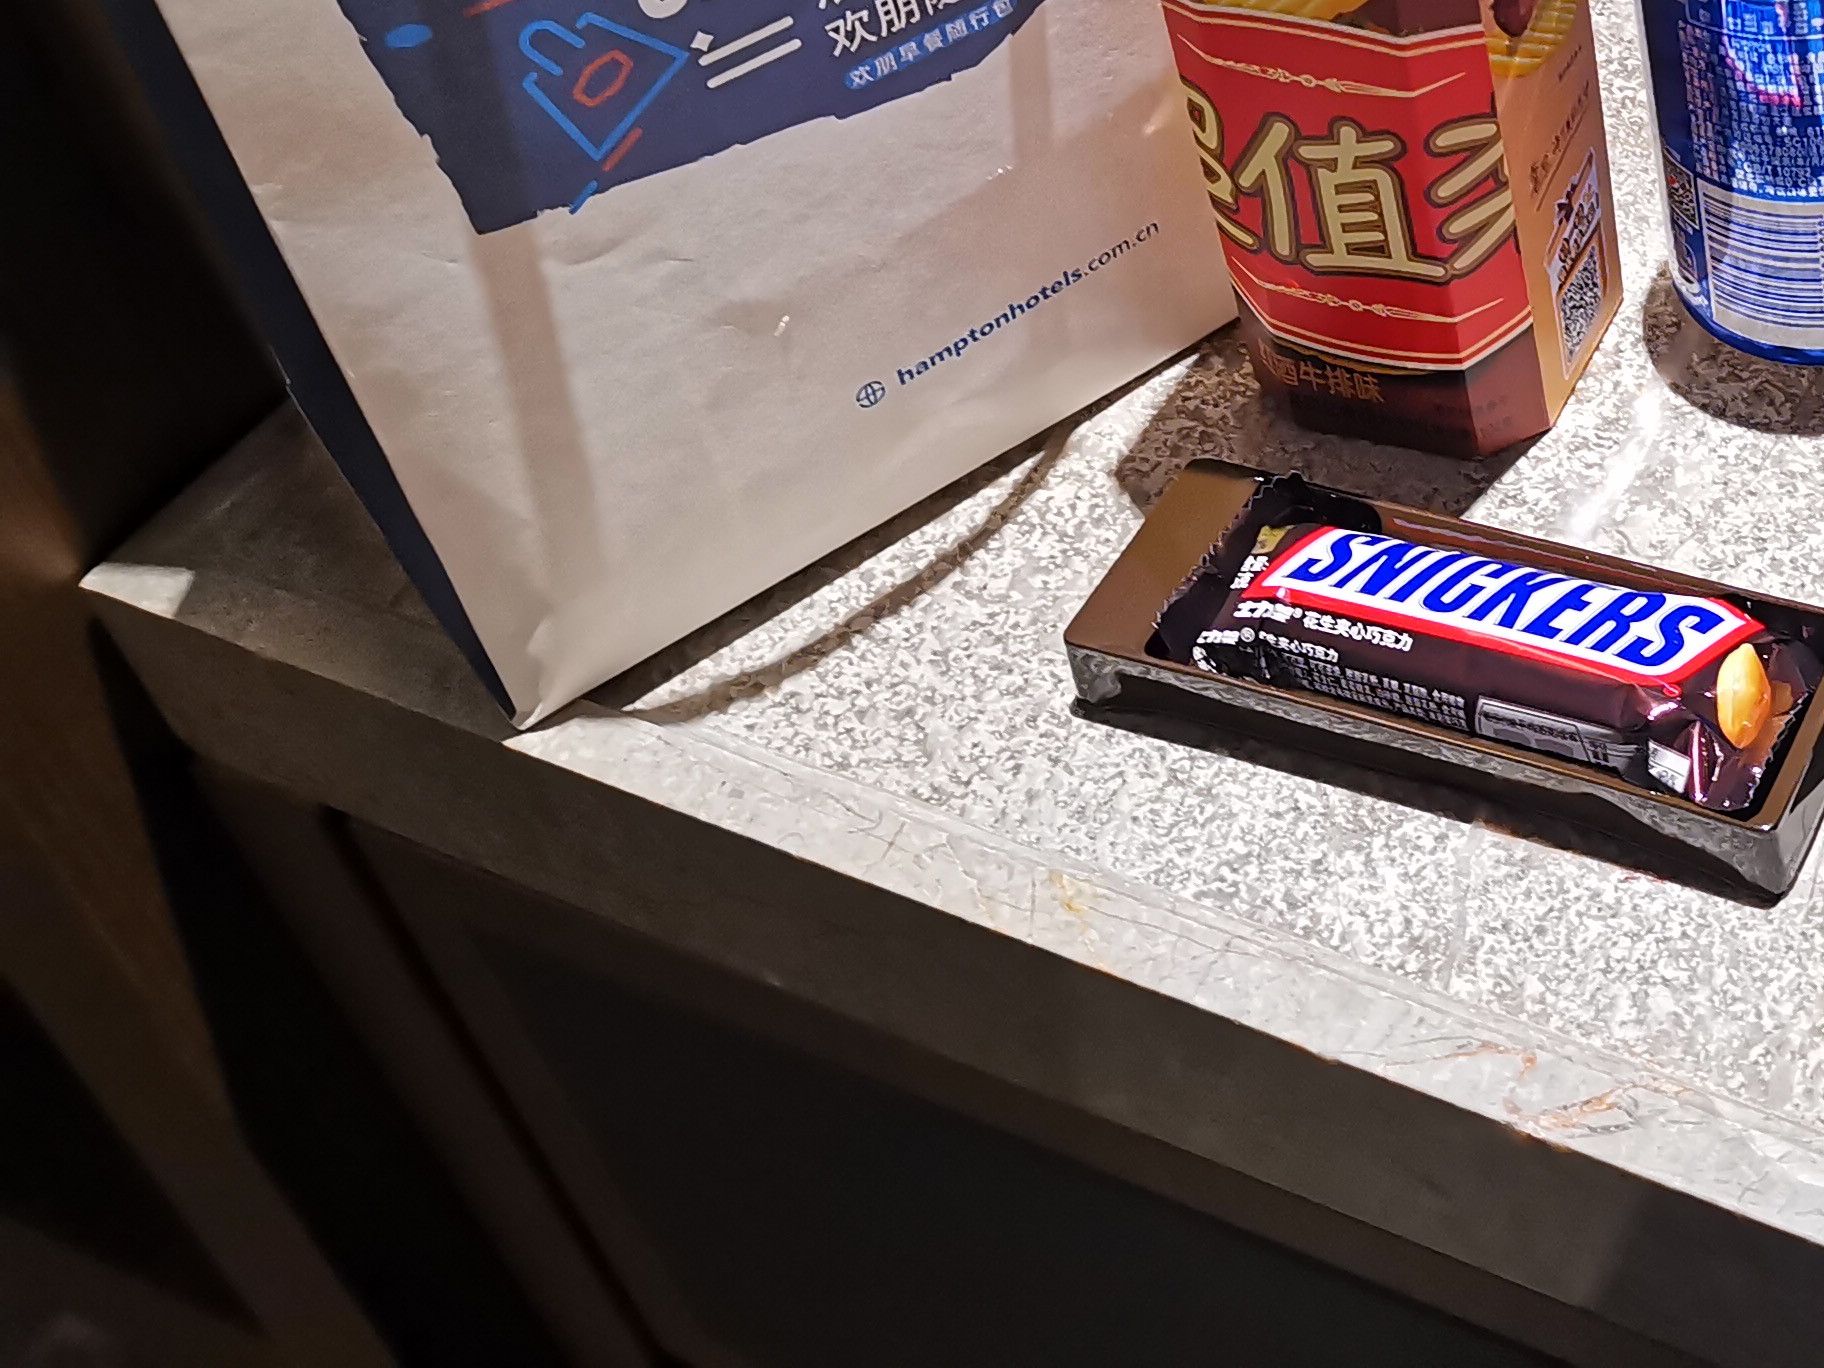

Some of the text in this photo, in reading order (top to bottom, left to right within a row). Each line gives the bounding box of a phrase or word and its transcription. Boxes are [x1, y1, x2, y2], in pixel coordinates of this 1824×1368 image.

[896, 220, 1160, 386] hamptonhotels.com.cn
[1283, 532, 1726, 668] SNICKERS
[1302, 610, 1414, 652] 花生夹心巧克力
